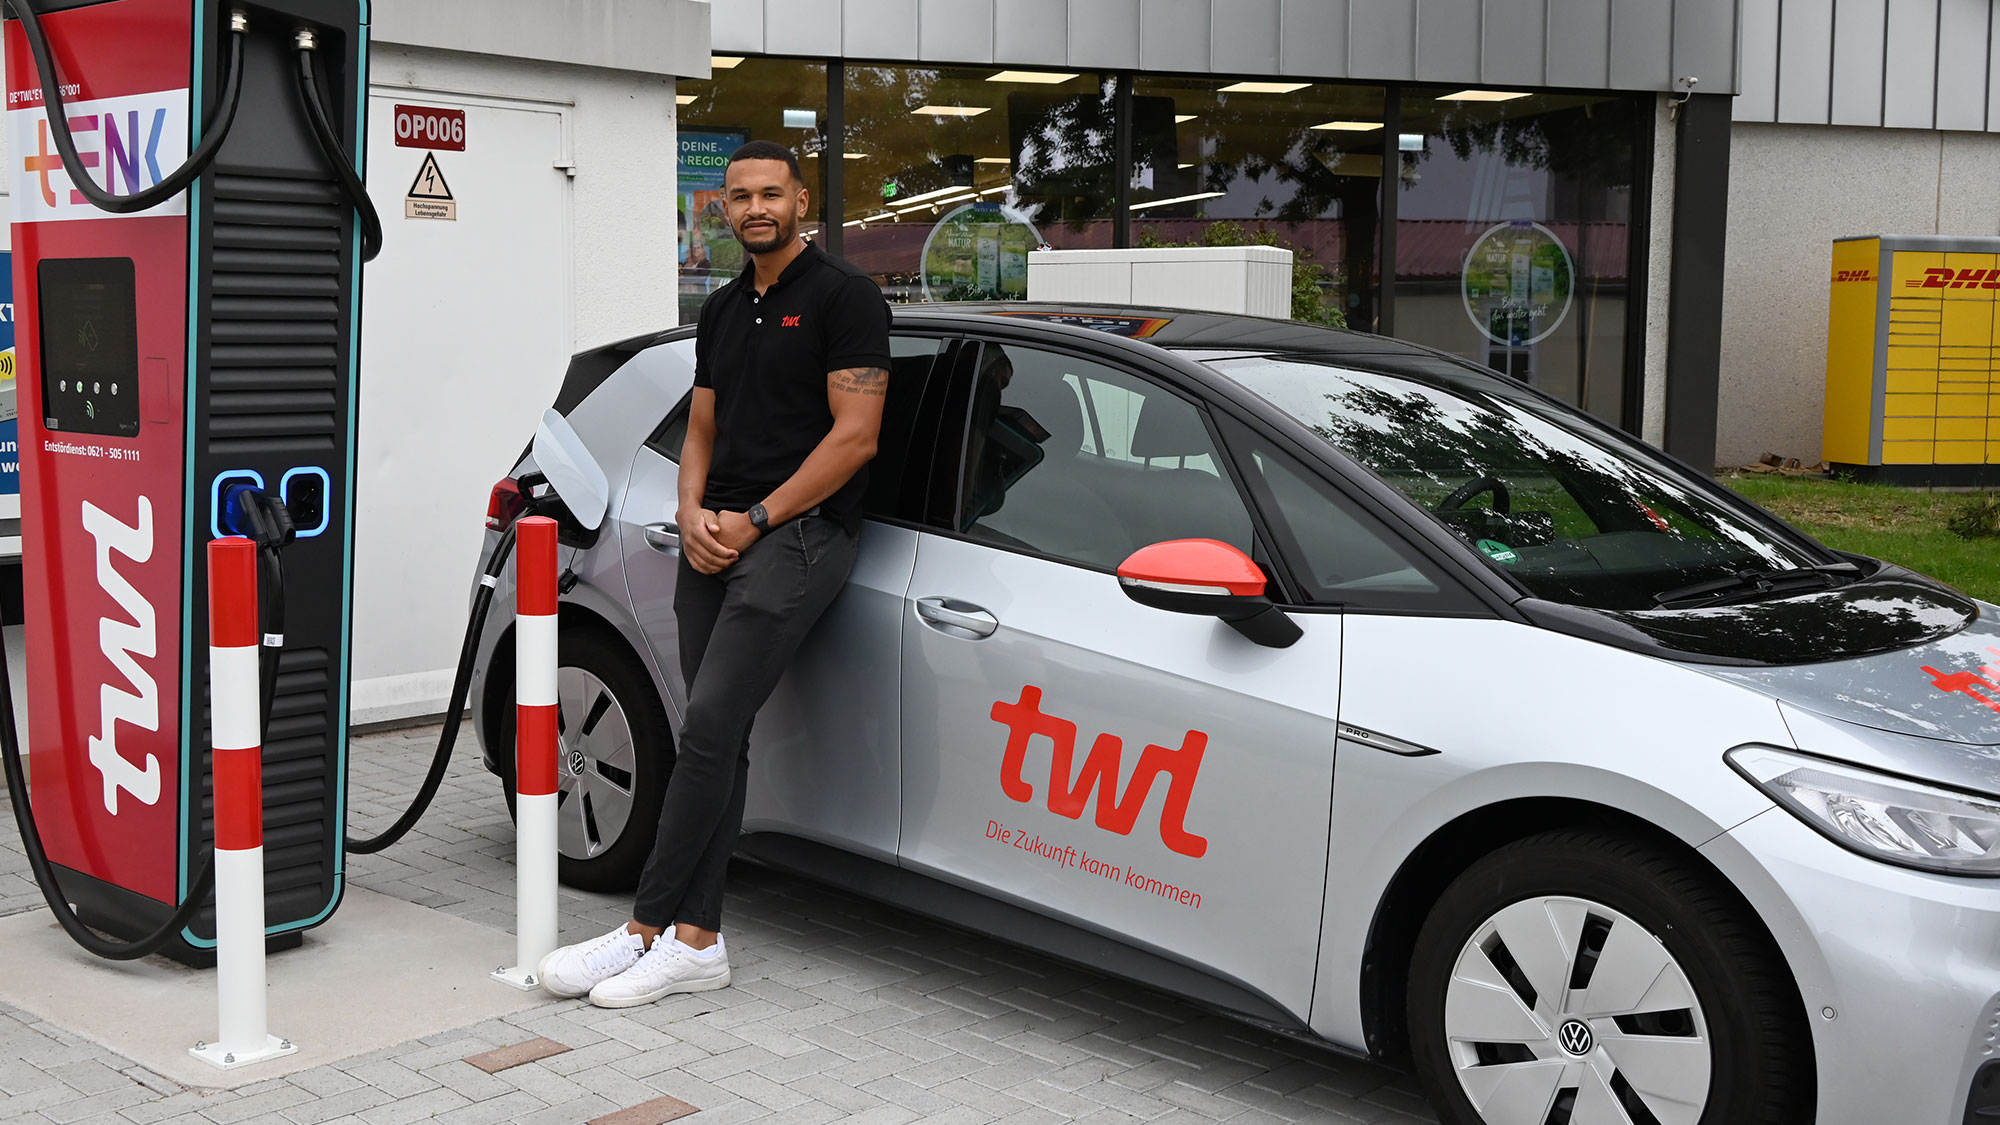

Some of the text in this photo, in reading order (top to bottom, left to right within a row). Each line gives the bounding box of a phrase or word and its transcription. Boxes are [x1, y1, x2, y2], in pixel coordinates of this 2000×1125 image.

[396, 113, 464, 143] OP006
[681, 141, 718, 152] DEINE
[413, 202, 449, 212] Hochspannung
[414, 207, 447, 218] Lebensgefahr
[948, 238, 971, 248] NATUR
[1836, 270, 1871, 282] DHL
[44, 440, 87, 456] Entstördienst:
[87, 445, 104, 457] 0621
[109, 447, 122, 460] 505
[123, 449, 140, 461] 1111
[82, 495, 161, 816] twl
[1345, 727, 1369, 739] PRO
[990, 684, 1209, 859] twl
[985, 819, 1202, 909] Die Zukunft kann kommen
